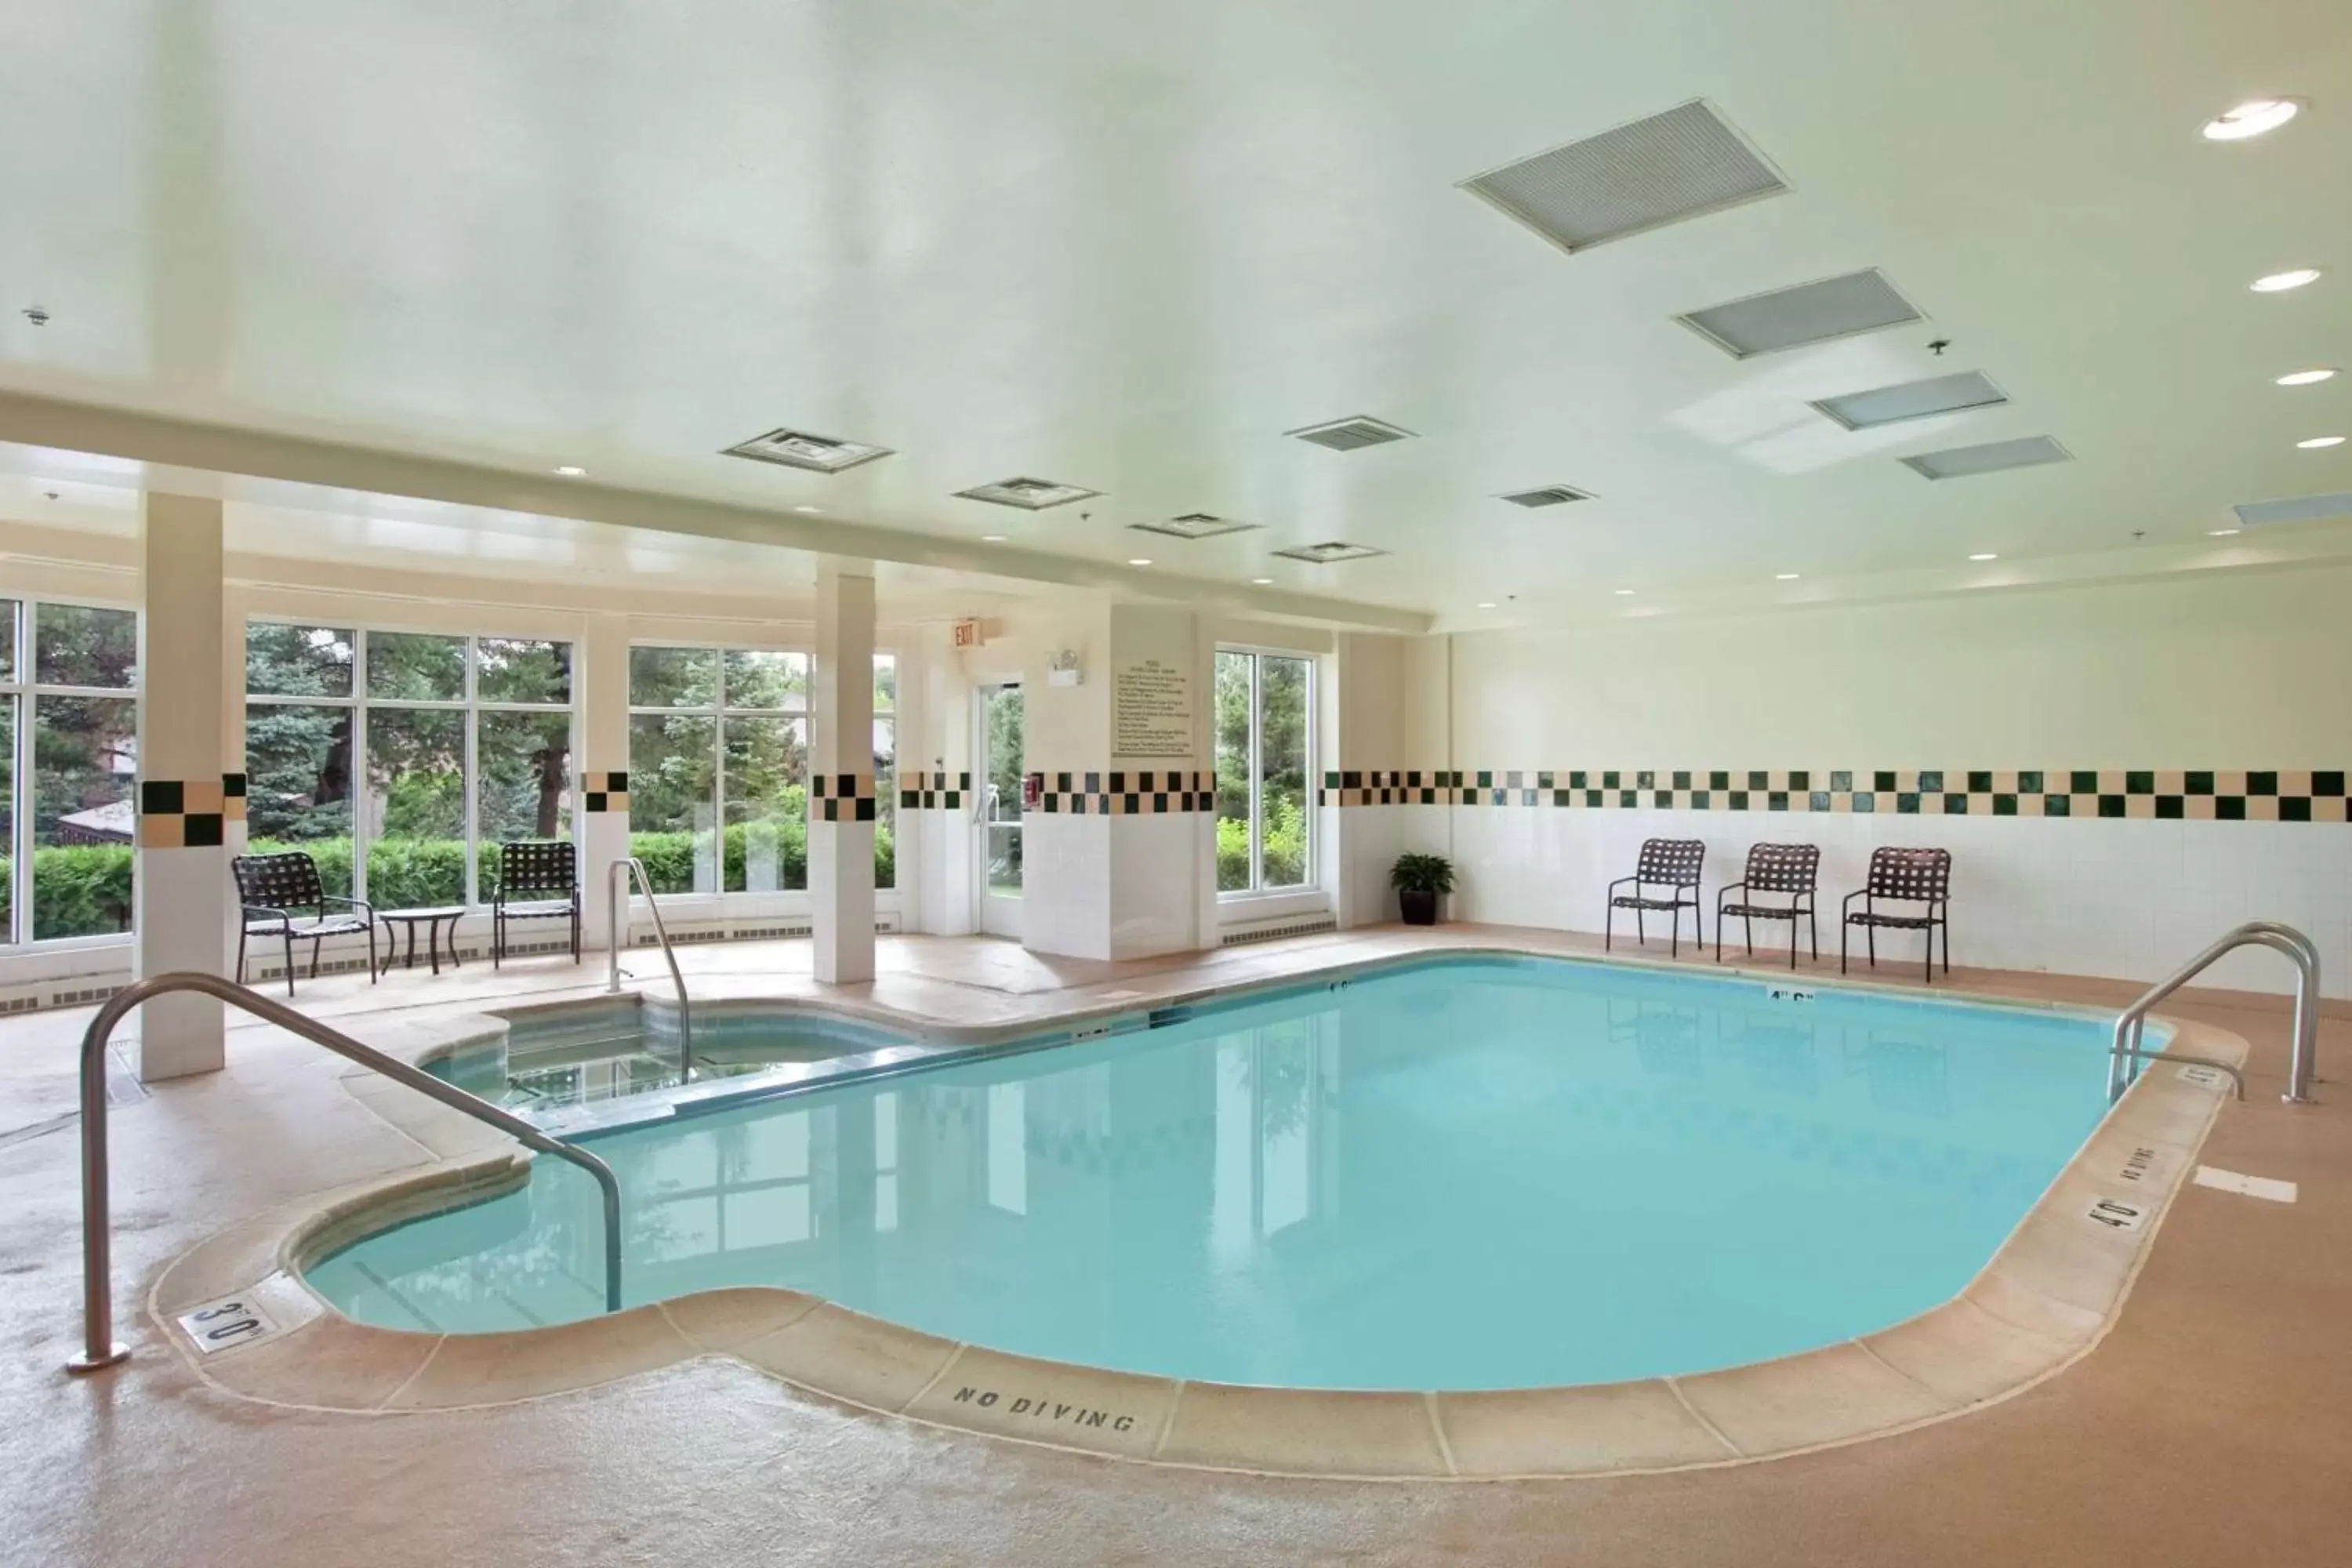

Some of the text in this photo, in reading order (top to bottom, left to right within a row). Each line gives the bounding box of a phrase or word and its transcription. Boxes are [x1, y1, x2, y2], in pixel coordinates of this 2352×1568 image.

[956, 624, 973, 647] EXIT
[953, 1387, 1134, 1432] NO DIVING
